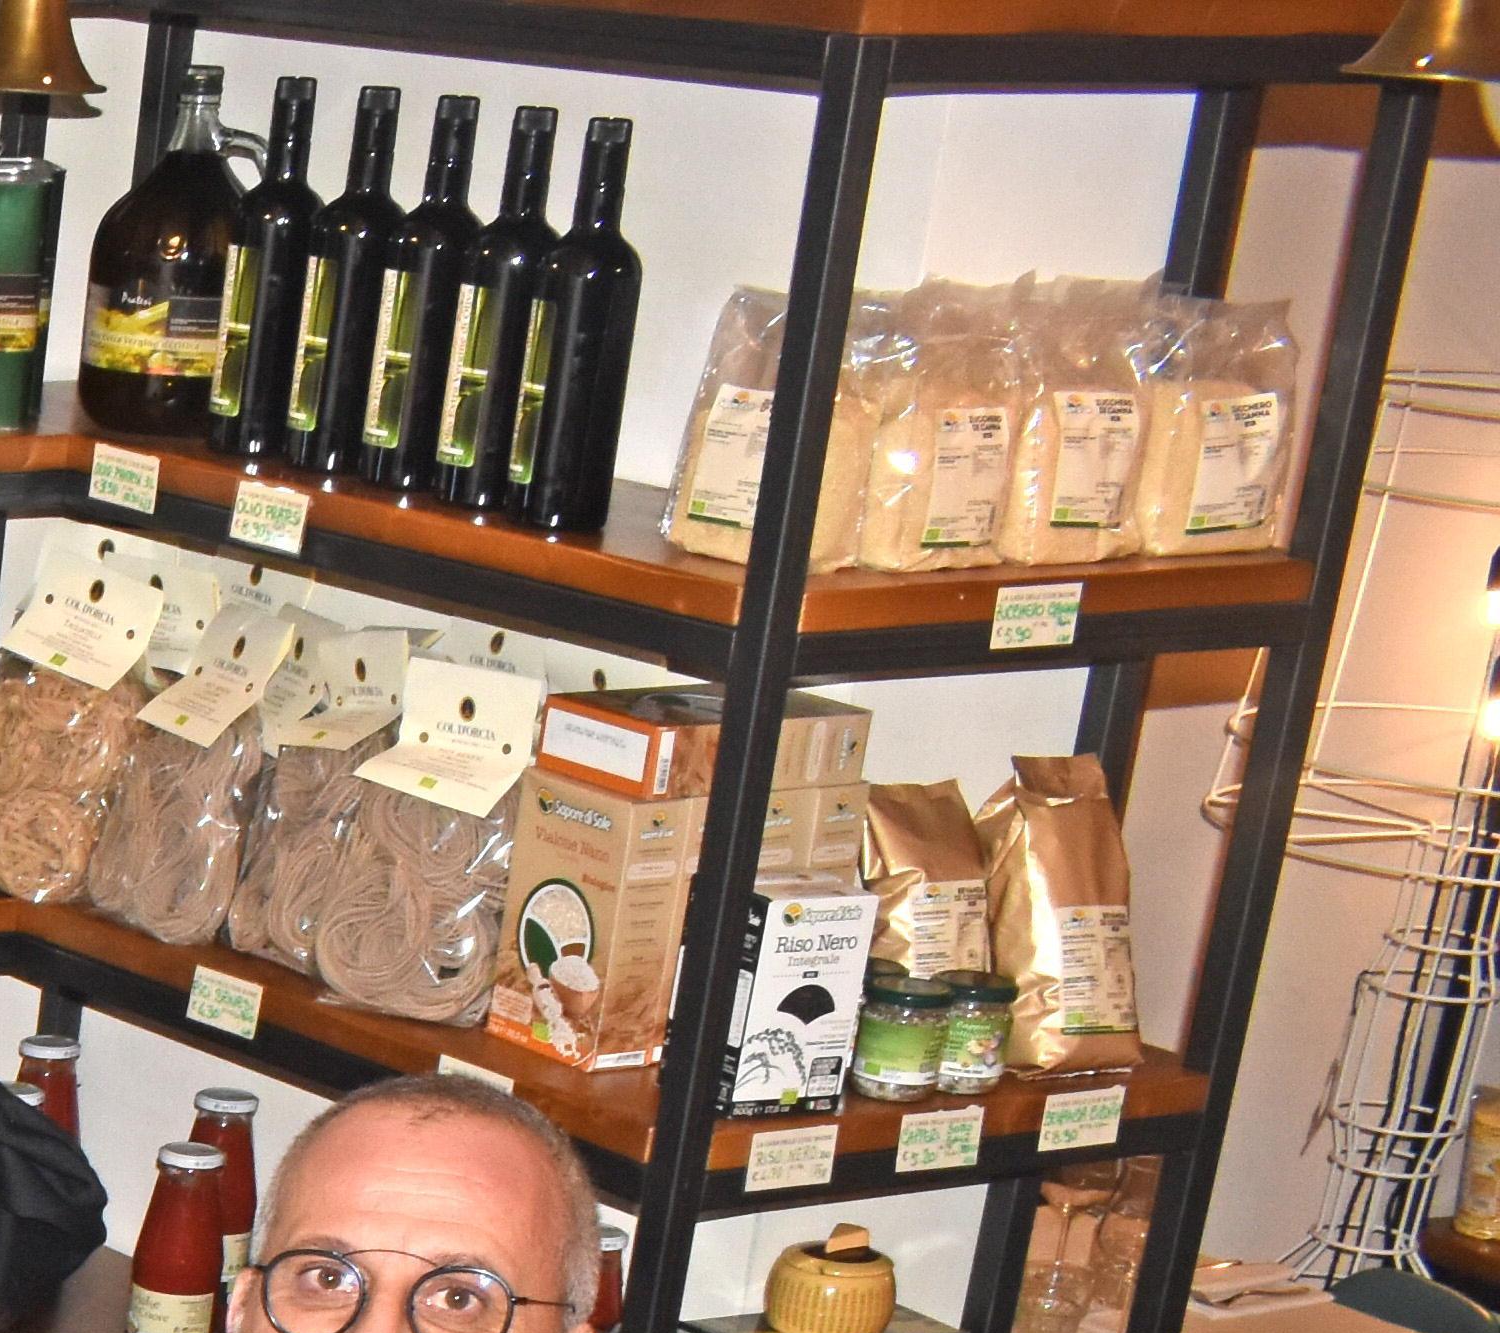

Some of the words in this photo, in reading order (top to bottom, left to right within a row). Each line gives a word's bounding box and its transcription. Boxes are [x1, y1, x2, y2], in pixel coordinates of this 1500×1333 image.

[554, 800, 584, 822] Sapore
[593, 812, 613, 832] Sole
[775, 934, 813, 954] Riso
[818, 932, 858, 951] Nero
[787, 951, 842, 969] Integrale
